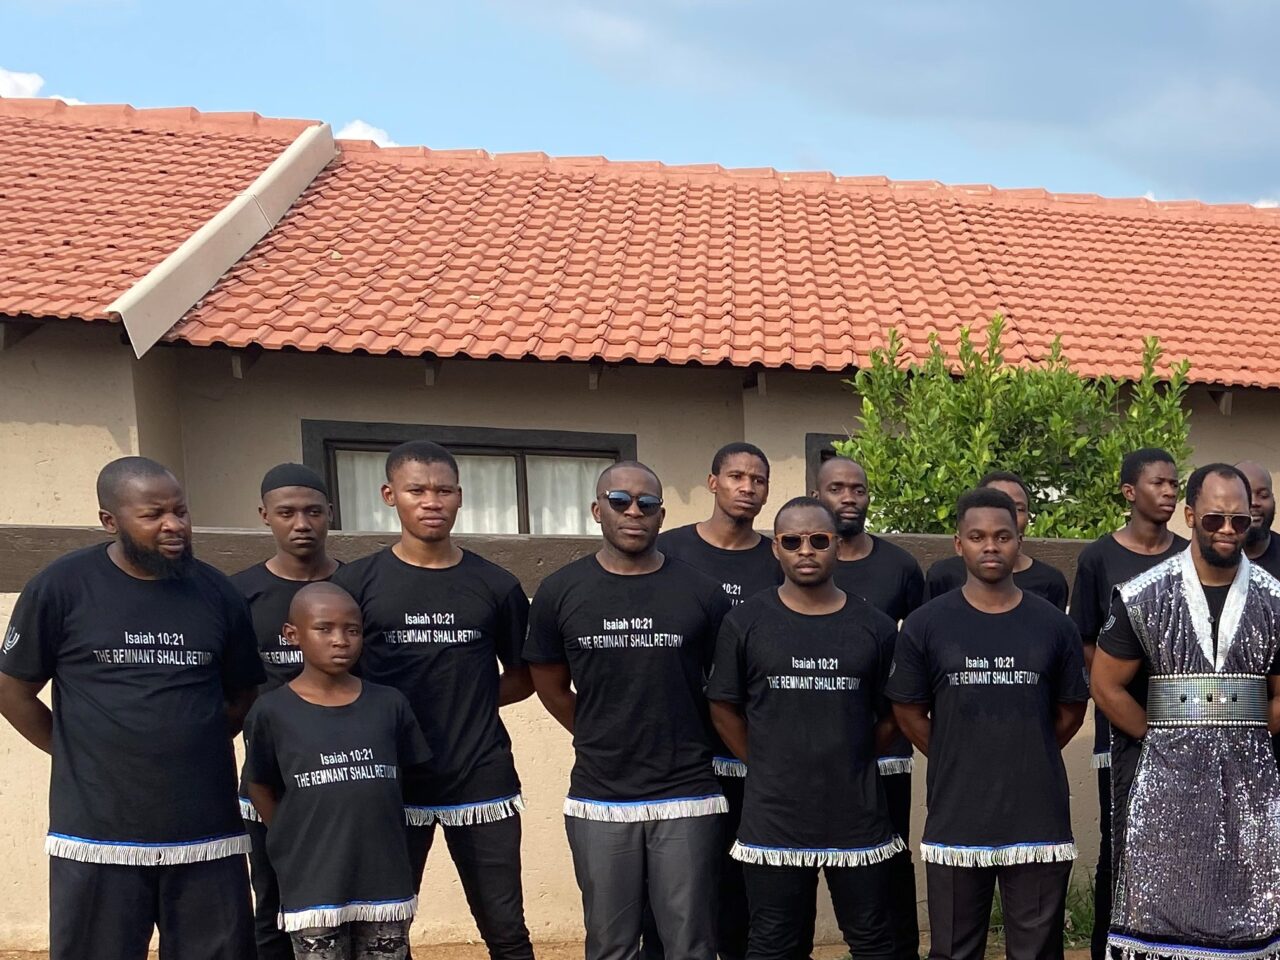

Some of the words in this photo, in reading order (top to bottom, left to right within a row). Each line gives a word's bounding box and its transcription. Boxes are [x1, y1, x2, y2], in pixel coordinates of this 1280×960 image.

[722, 583, 741, 595] 10:21
[405, 613, 430, 624] Isaiah
[432, 613, 454, 624] 10:21
[603, 618, 628, 630] Isaiah
[631, 618, 653, 629] 10:21
[125, 631, 155, 644] Isaiah
[157, 632, 184, 645] 10:21
[397, 629, 431, 643] REMNANT
[433, 630, 457, 642] SHALL
[578, 637, 592, 649] THE
[593, 635, 628, 648] REMNANT
[630, 634, 653, 647] SHALL
[93, 650, 112, 663] THE
[113, 649, 155, 663] REMNANT
[157, 650, 185, 665] SHALL
[792, 657, 816, 669] Isaiah
[818, 658, 838, 670] 10:21
[965, 656, 989, 668] Isaiah
[994, 657, 1014, 668] 10:21
[767, 676, 780, 688] THE
[781, 676, 813, 689] REMNANT
[814, 677, 836, 690] SHALL
[947, 673, 959, 685] THE
[960, 672, 991, 684] REMNANT
[992, 671, 1014, 684] SHALL
[320, 751, 348, 765] Isaiah
[350, 748, 373, 761] 10:21
[294, 772, 310, 788] THE
[311, 767, 348, 785] REMNANT
[350, 765, 375, 780] SHALL
